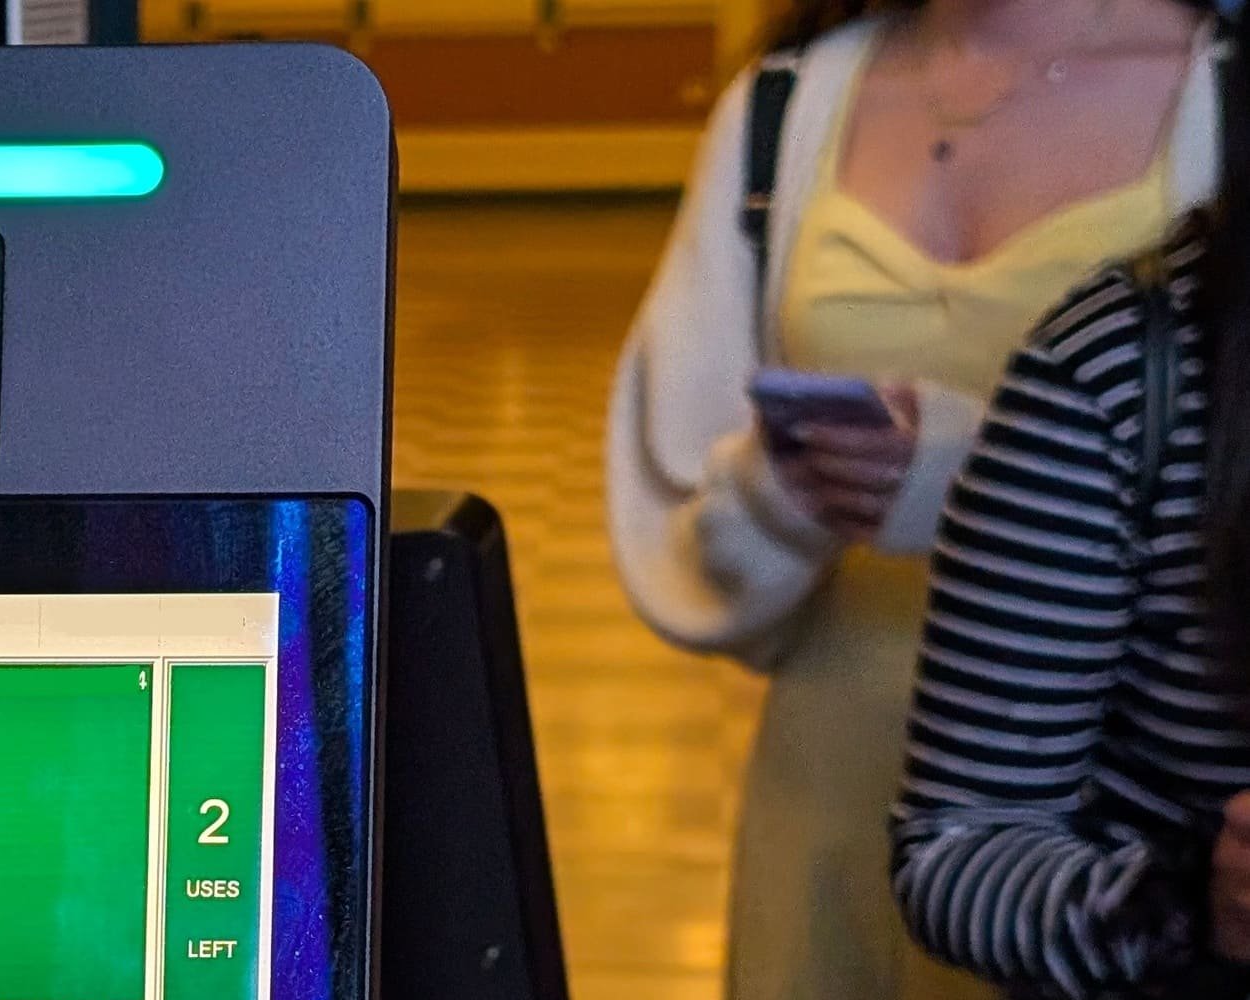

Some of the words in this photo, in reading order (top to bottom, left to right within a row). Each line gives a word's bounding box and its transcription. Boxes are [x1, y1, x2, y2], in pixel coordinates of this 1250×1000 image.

[197, 798, 230, 844] 2
[186, 880, 240, 898] USES
[188, 940, 238, 958] LEFT
